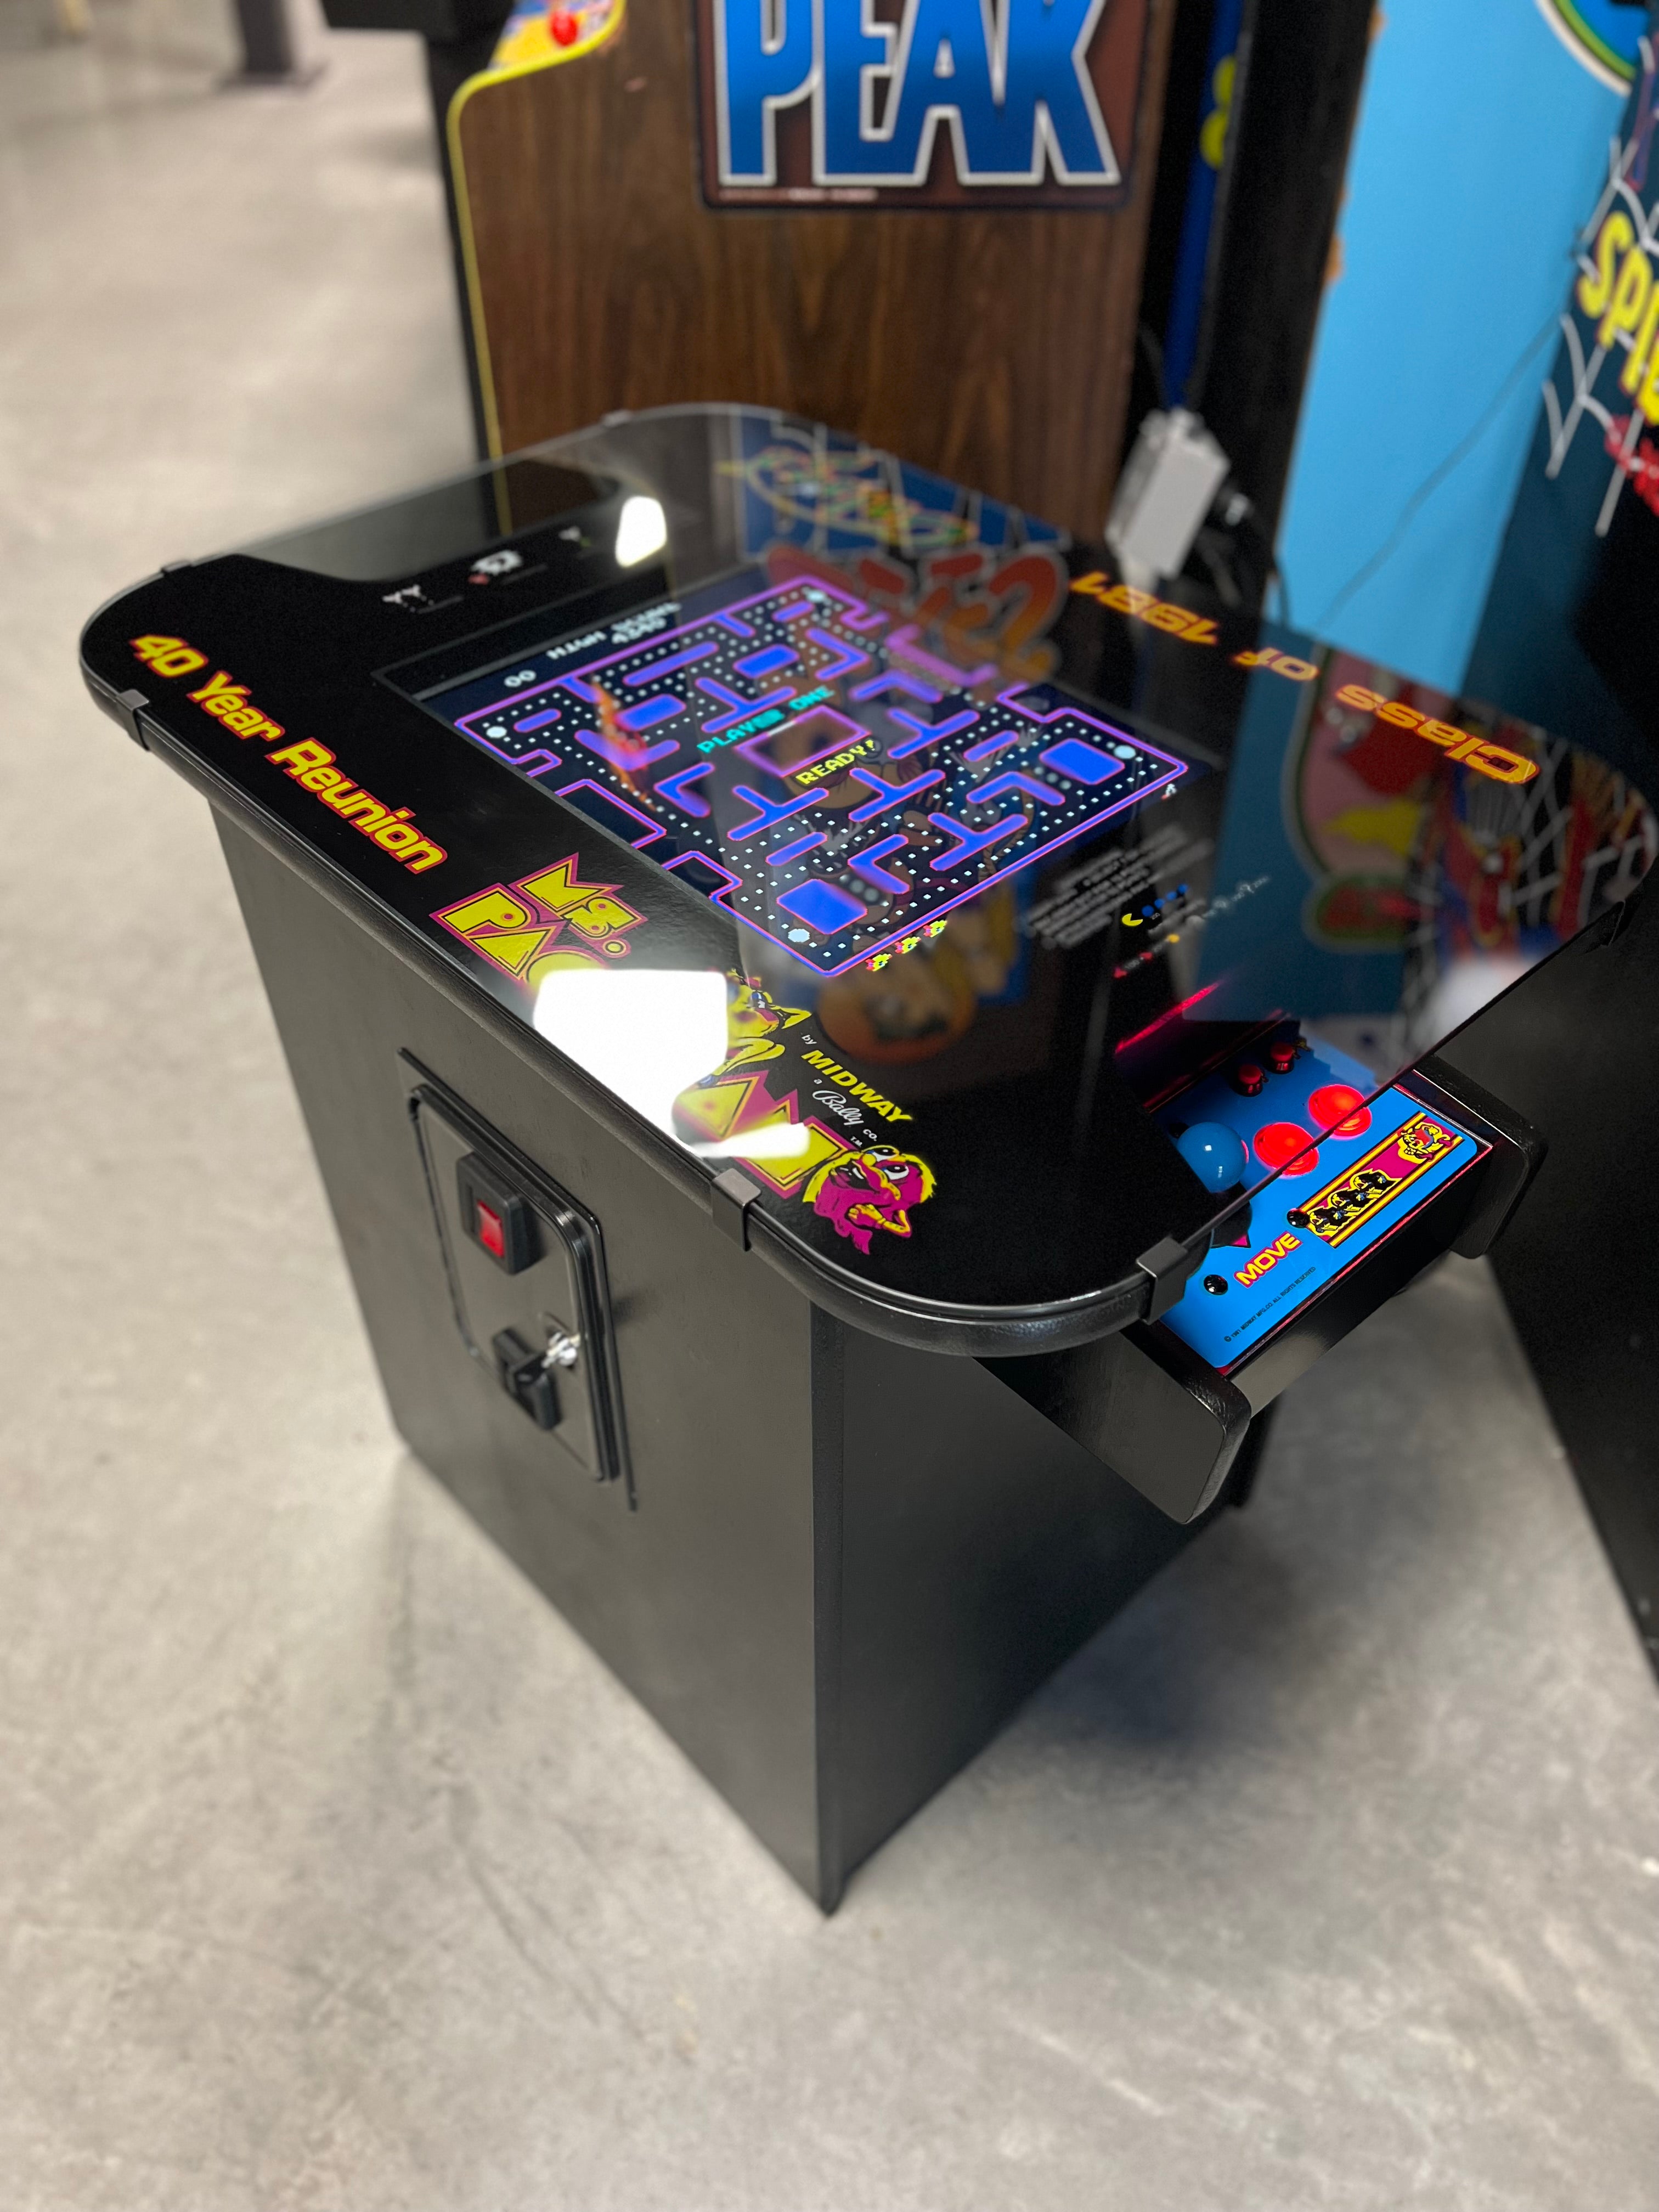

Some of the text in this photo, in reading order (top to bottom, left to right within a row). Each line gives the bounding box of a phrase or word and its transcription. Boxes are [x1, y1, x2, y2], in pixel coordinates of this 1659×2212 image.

[718, 0, 1122, 187] PEAK
[1069, 571, 1220, 645] 1981
[504, 670, 537, 687] 00
[697, 686, 835, 754] PLAY ONE
[1335, 683, 1539, 785] Class
[129, 634, 448, 874] 40 Year Reunion
[795, 739, 876, 785] READY!
[801, 1035, 817, 1045] by
[800, 1049, 913, 1122] MIDWAY
[812, 1090, 865, 1126] Bally
[1234, 1232, 1302, 1287] MOVE
[1240, 1316, 1257, 1330] MIDWAY
[1272, 1295, 1282, 1304] ALL
[1279, 1282, 1296, 1297] RIGHTS
[1294, 1266, 1317, 1285] RESERVED
